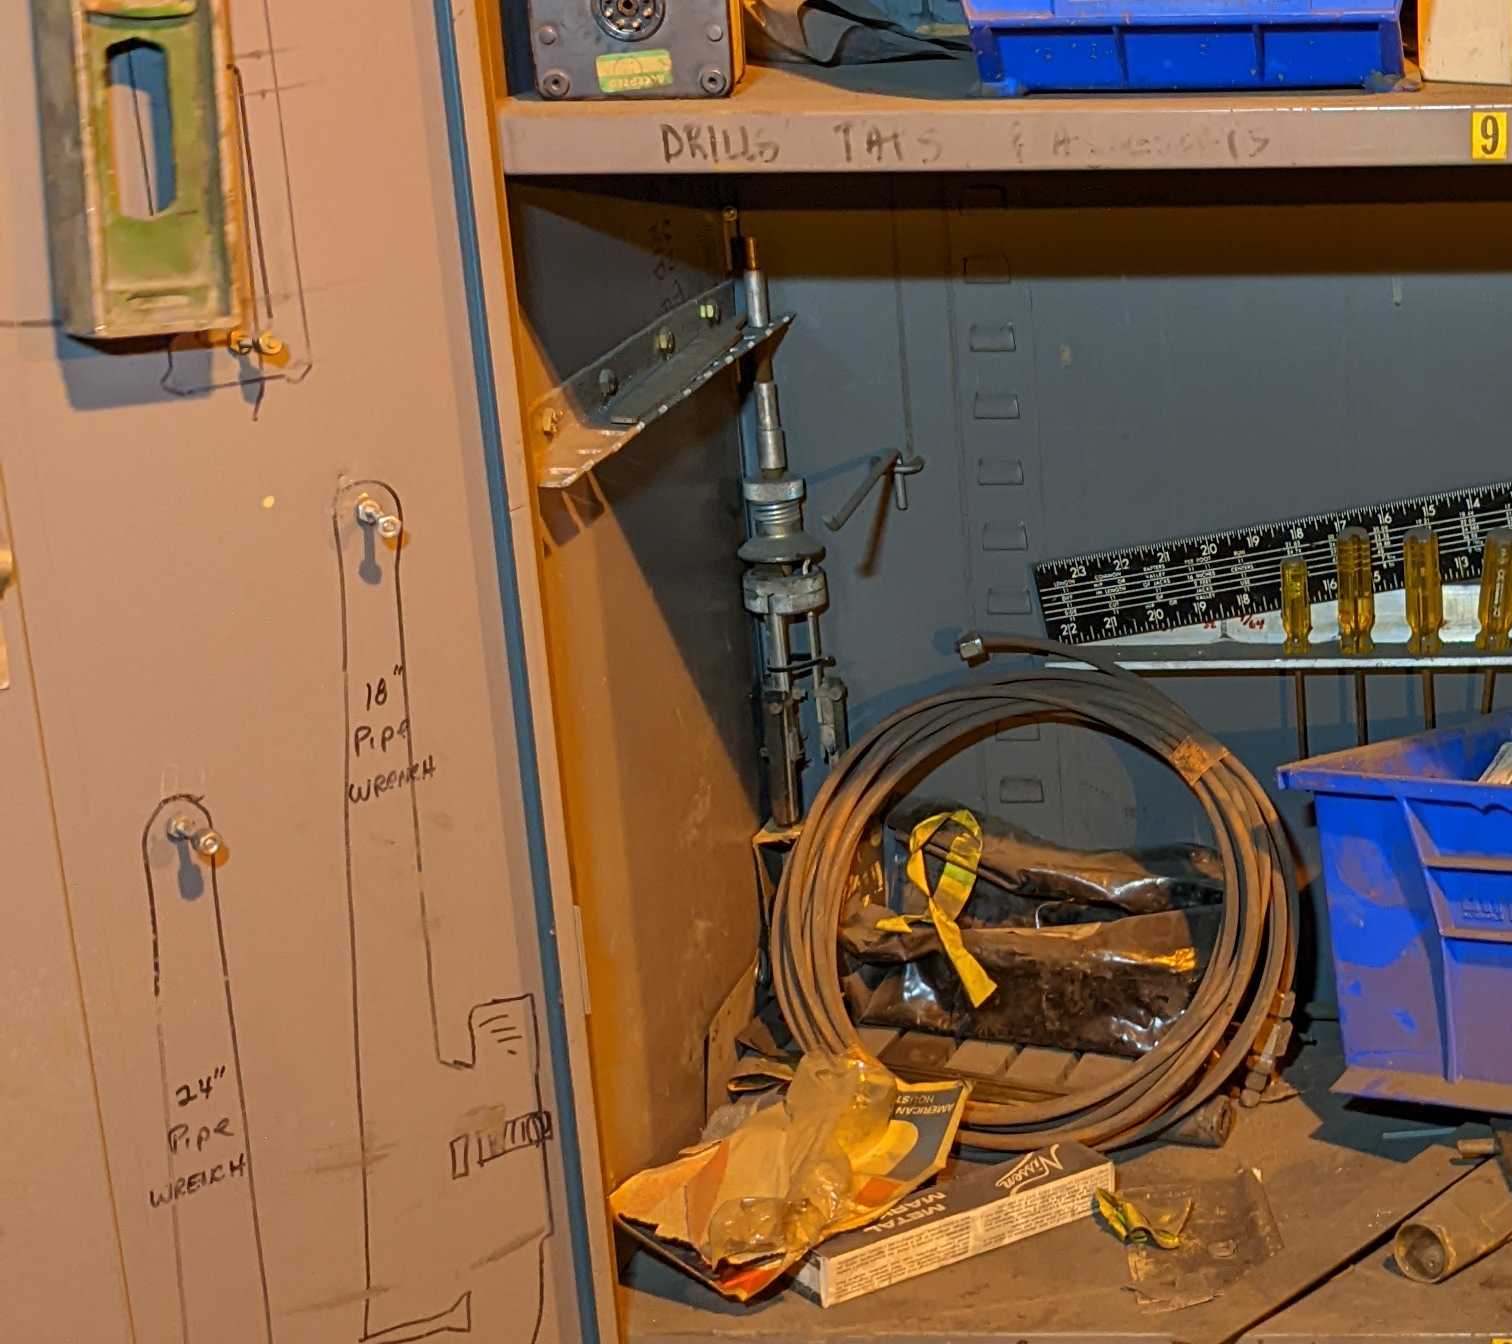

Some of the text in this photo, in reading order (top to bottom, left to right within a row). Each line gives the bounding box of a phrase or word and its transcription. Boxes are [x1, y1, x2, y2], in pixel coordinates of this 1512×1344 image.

[660, 122, 780, 164] DRILLS
[1481, 115, 1500, 154] 9
[1070, 565, 1087, 578] 23
[1113, 558, 1130, 572] 22
[1157, 552, 1171, 564] 21
[1200, 543, 1218, 556] 20
[1246, 536, 1261, 548] 19
[1290, 528, 1305, 540] 18
[1378, 513, 1393, 525] 16
[1422, 505, 1436, 517] 15
[1467, 498, 1481, 509] 14
[366, 664, 404, 708] 18"
[175, 1065, 227, 1108] 24"
[149, 1155, 248, 1210] WRENCH
[994, 1143, 1064, 1197] Nissen
[863, 1202, 946, 1233] METAL
